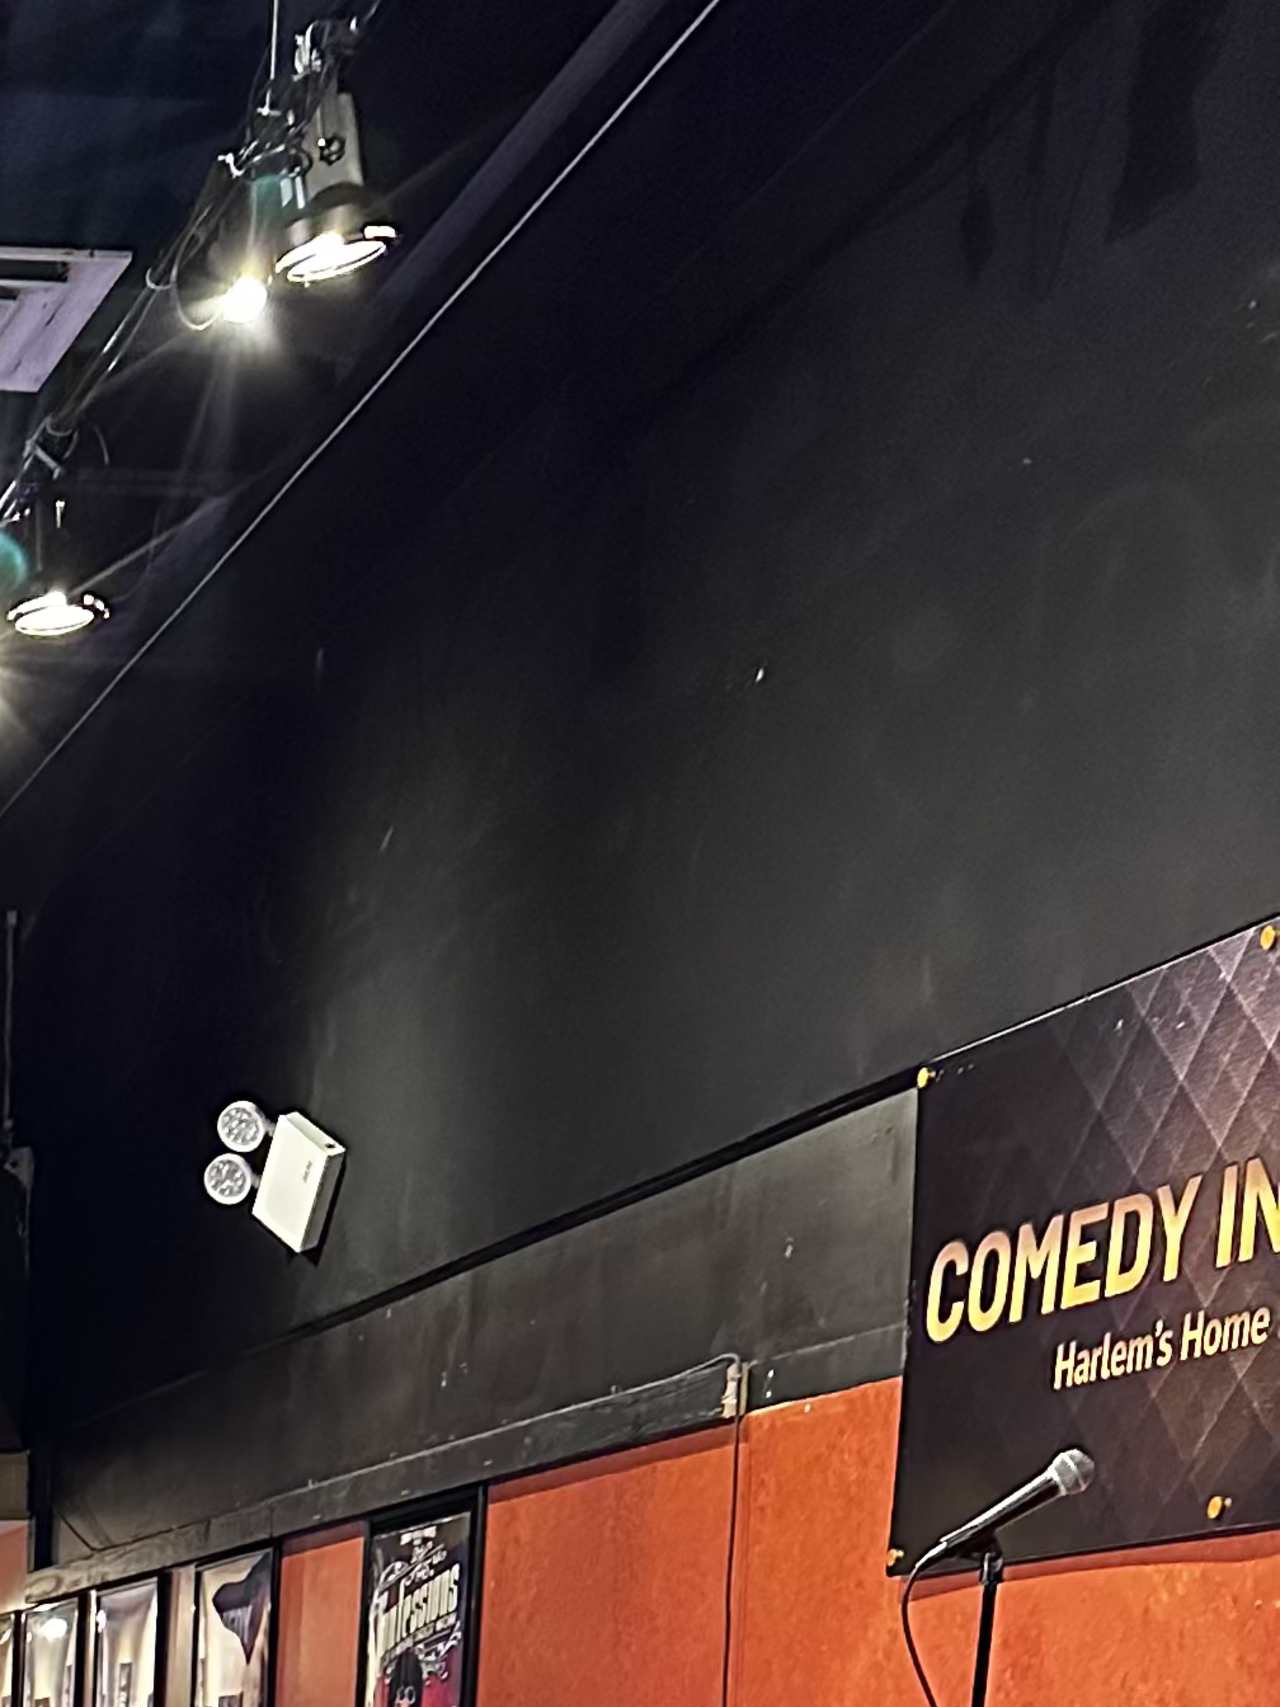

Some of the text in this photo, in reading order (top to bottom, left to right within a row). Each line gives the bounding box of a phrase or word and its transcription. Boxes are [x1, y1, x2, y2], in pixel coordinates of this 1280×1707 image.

[925, 1155, 1280, 1343] COMEDY IN
[1052, 1305, 1272, 1390] Harlem's Home
